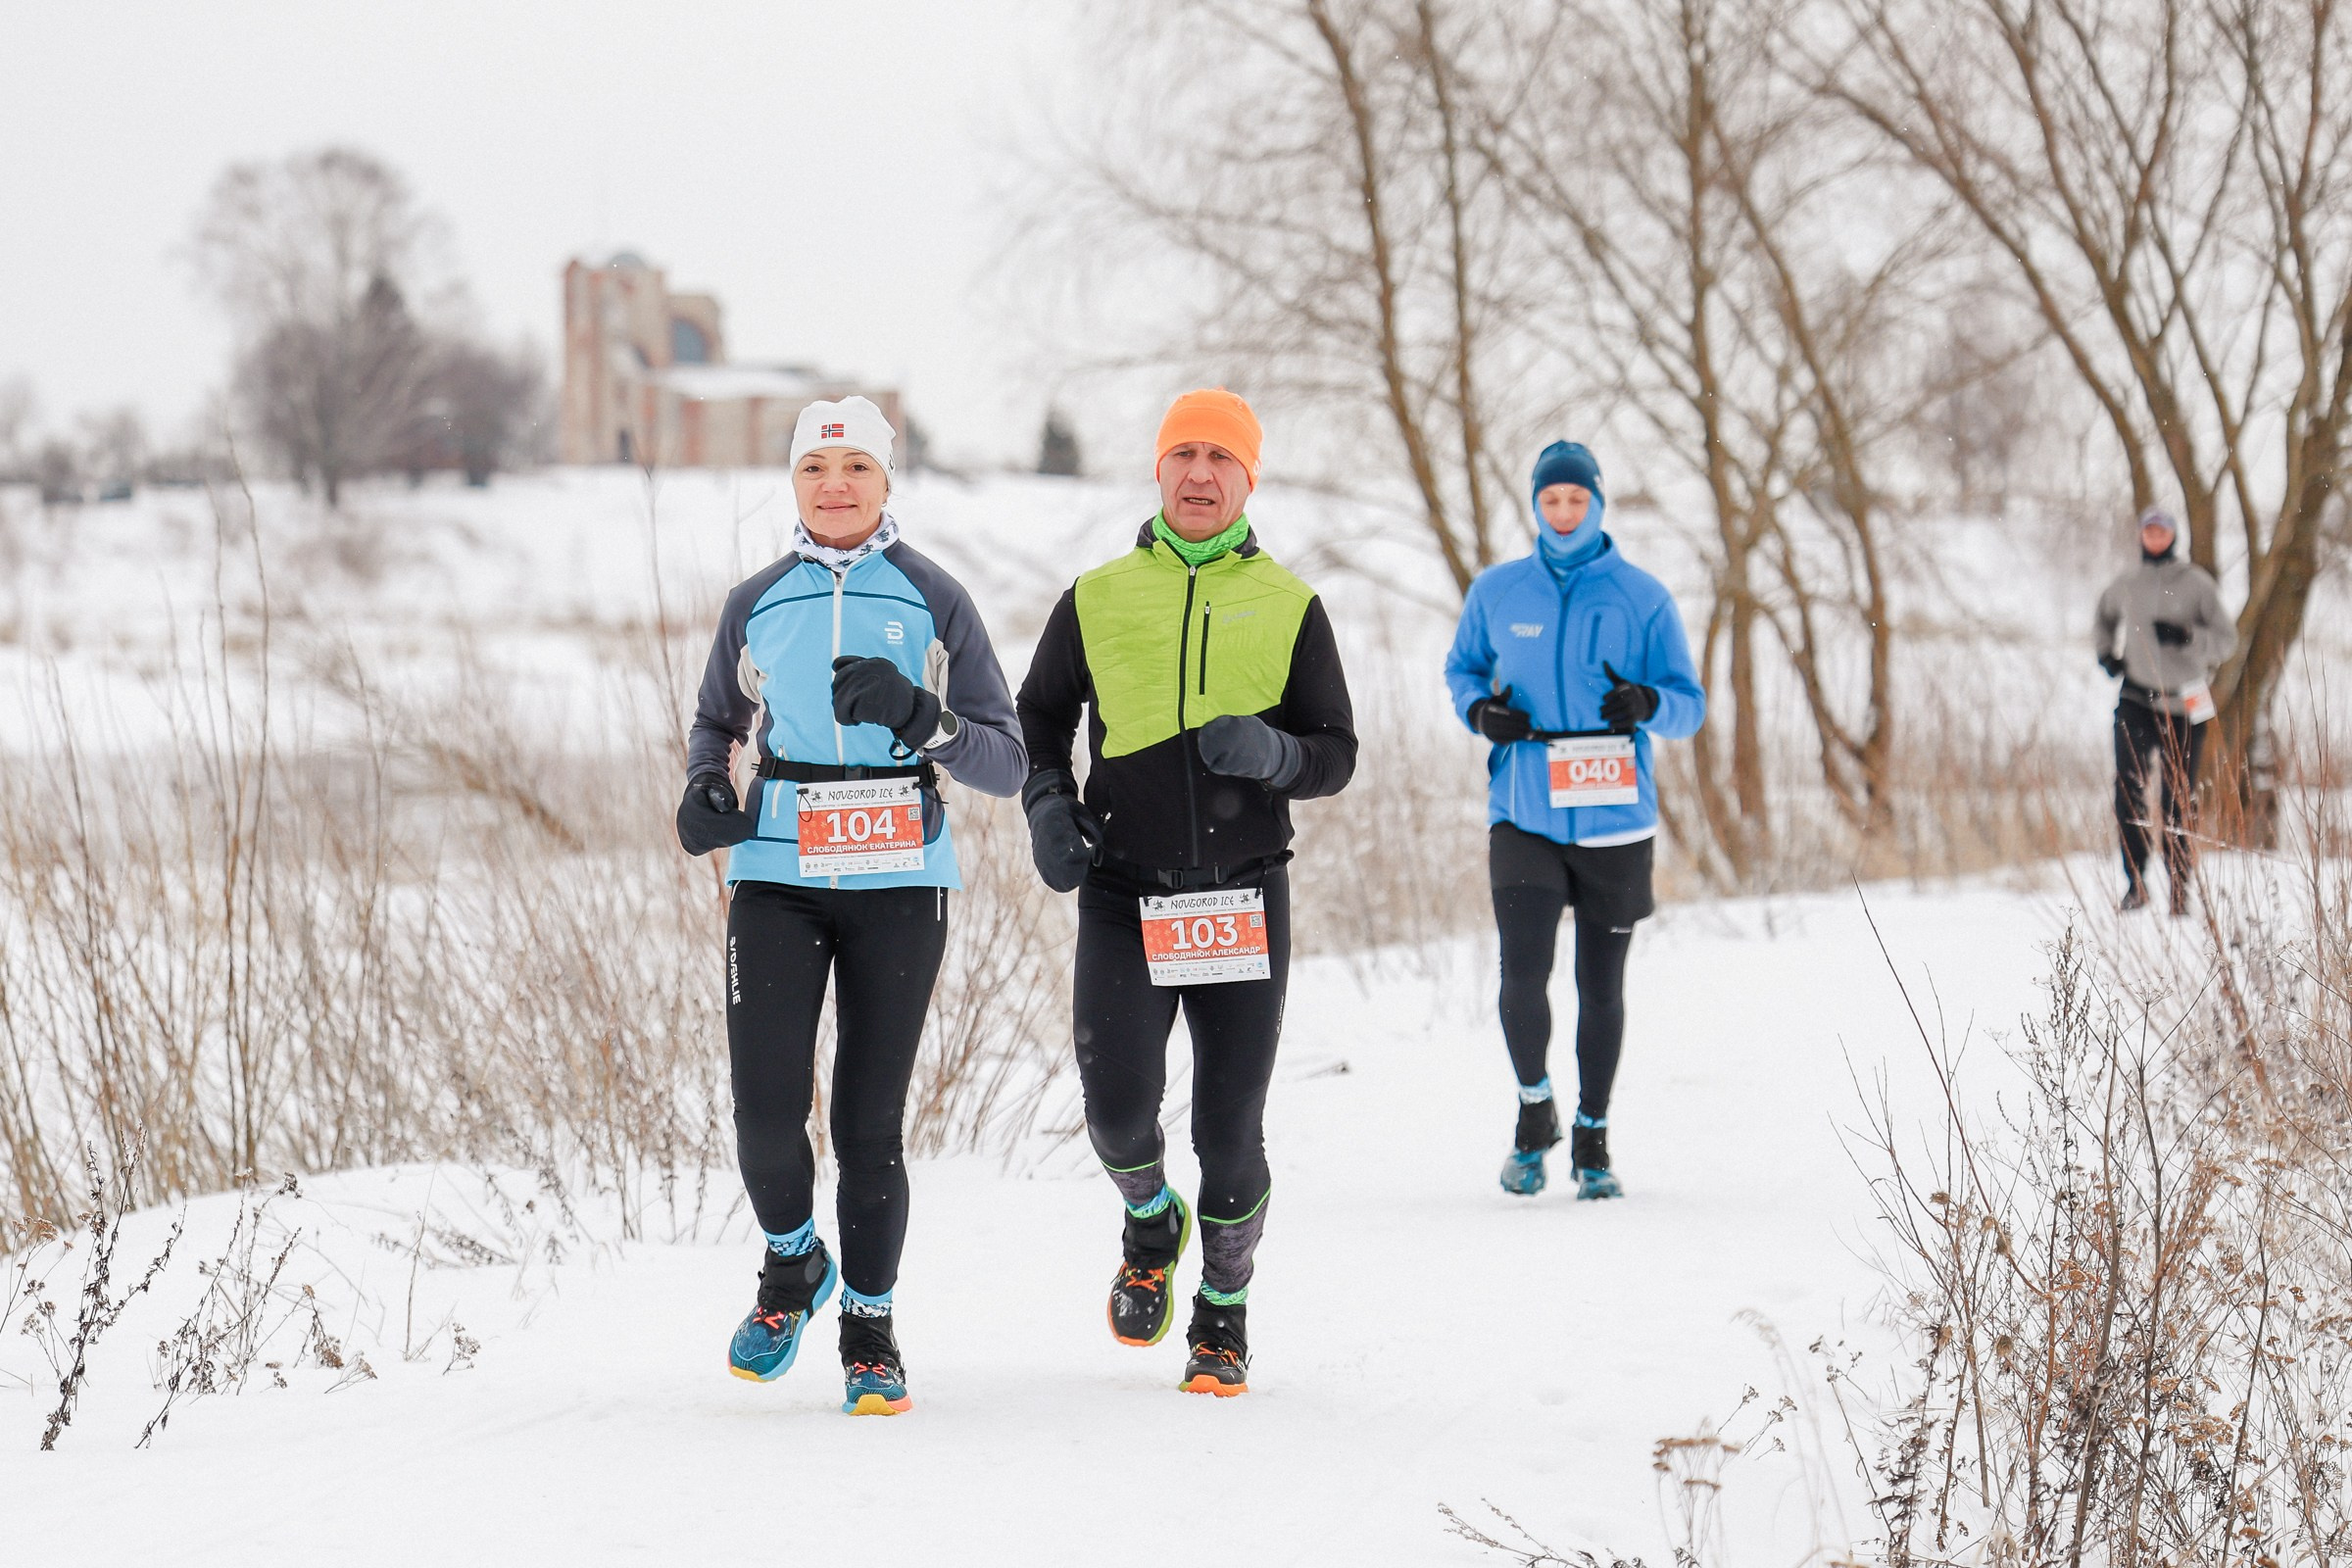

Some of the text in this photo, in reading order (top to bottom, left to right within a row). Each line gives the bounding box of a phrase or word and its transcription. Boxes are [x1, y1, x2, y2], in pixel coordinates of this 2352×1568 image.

[1568, 758, 1621, 784] 040
[828, 787, 894, 801] NOVGOROD ICE
[826, 808, 897, 844] 104
[807, 840, 917, 855] СЛОБОДЯНЮК ЕКАТЕРИНА
[1170, 896, 1234, 909] NOVGOROD ICE
[1170, 915, 1239, 951] 103
[1152, 946, 1261, 961] СЛОБОДЯНЮК АЛЕКСАНДР
